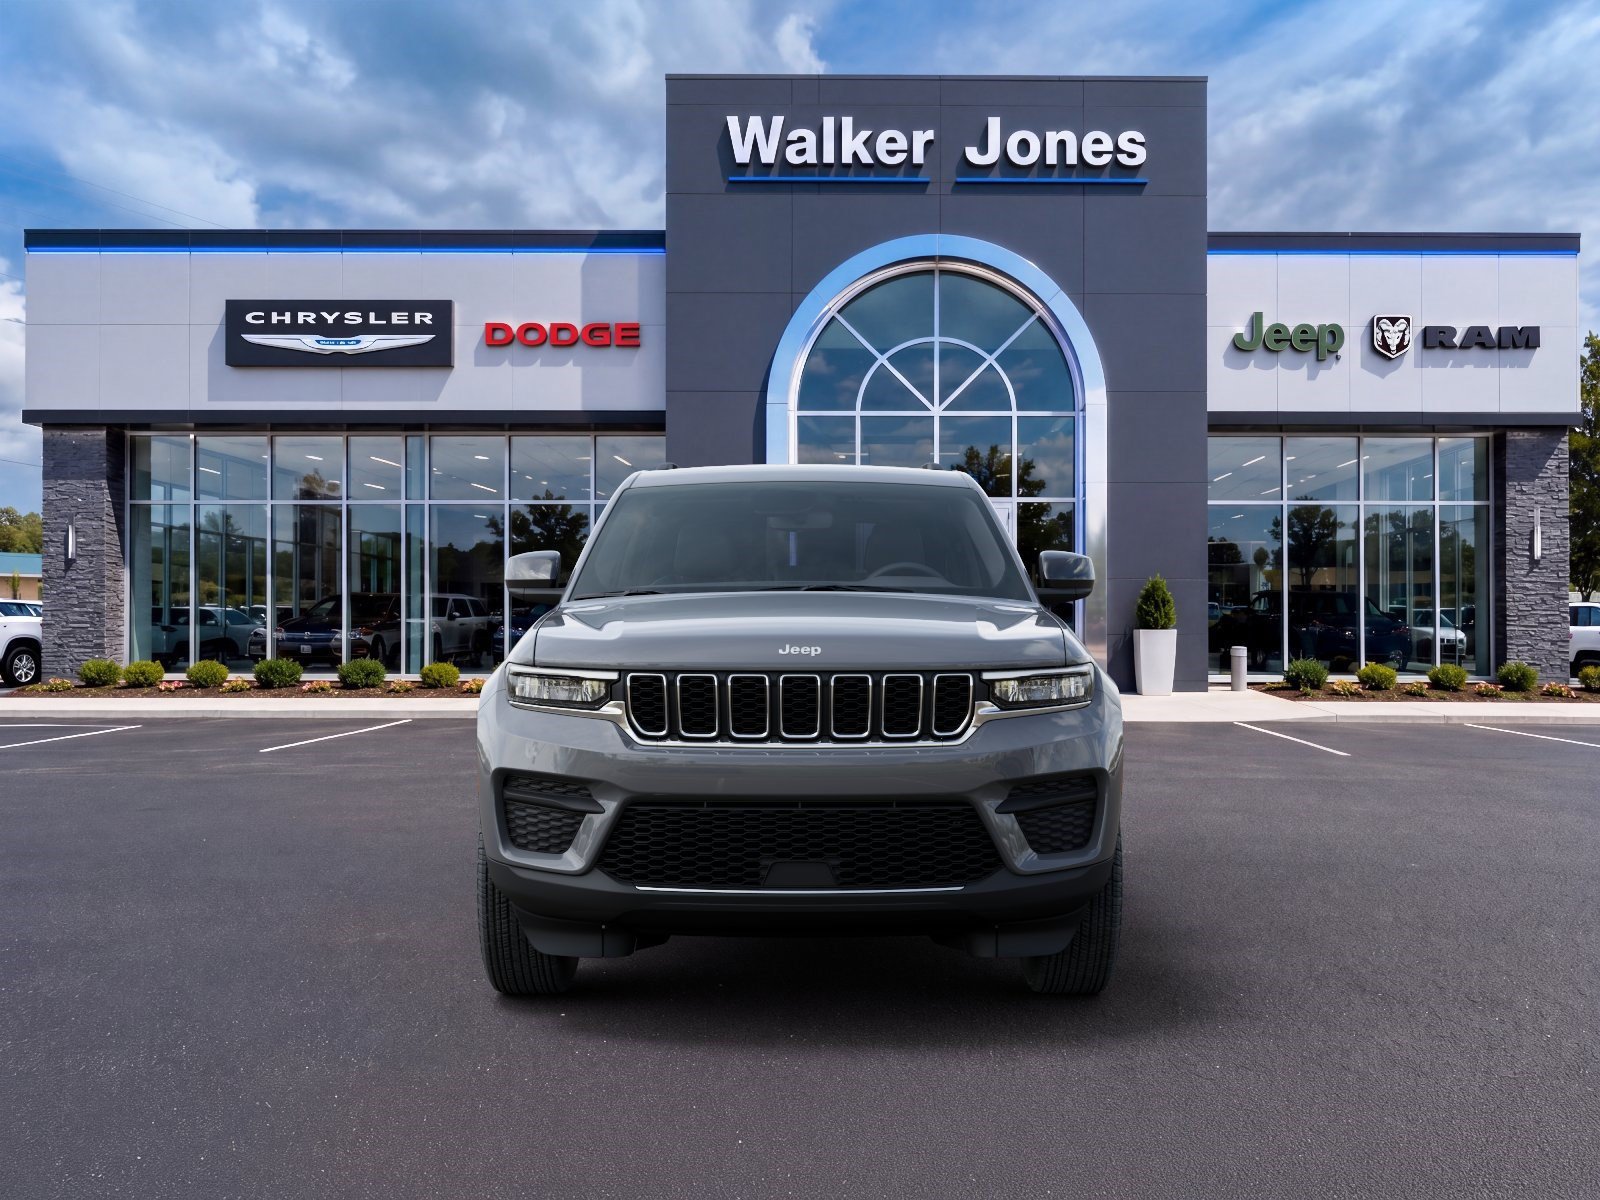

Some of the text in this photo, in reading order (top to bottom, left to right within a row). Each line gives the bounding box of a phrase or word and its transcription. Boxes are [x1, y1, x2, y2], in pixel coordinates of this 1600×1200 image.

[726, 115, 1148, 167] Walker Jones
[245, 312, 433, 325] CHRYSLER
[484, 322, 641, 348] DODGE
[1234, 311, 1345, 361] Jeep
[1423, 325, 1541, 350] RAM
[778, 644, 821, 656] Jeep
